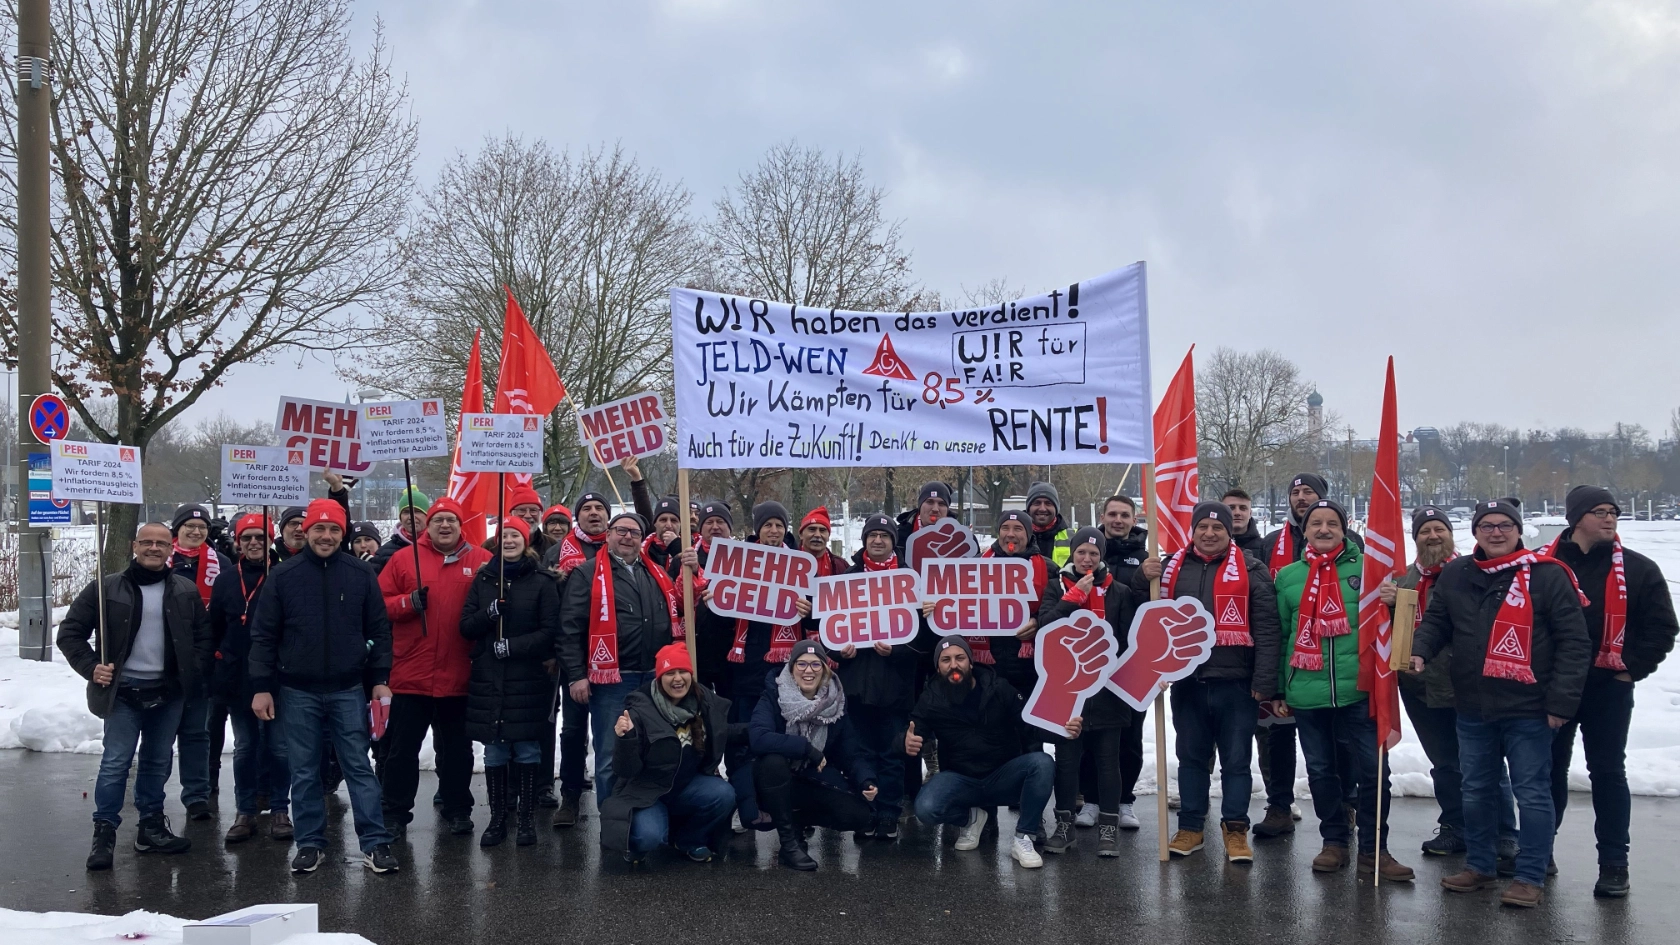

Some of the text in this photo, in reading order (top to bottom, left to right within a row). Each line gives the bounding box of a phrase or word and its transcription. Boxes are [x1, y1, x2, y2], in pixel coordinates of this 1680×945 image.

[695, 283, 1080, 335] W!R haben das verdient!
[696, 338, 848, 386] JELD-WEN
[957, 328, 1079, 364] W!R für
[963, 361, 1025, 384] FA!R
[370, 406, 392, 416] PERI
[707, 380, 759, 417] Wir
[876, 379, 918, 413] für
[922, 371, 966, 410] 8,5
[973, 388, 996, 405] %
[281, 402, 360, 439] MEH
[473, 418, 494, 426] PERI
[581, 395, 663, 440] MEHR
[688, 431, 723, 459] Auch
[728, 430, 755, 458] für
[759, 428, 784, 457] die
[923, 440, 940, 450] an
[944, 441, 987, 453] unsere
[987, 396, 1110, 455] RENTE!
[64, 445, 88, 454] PERI
[233, 449, 256, 458] PERI
[593, 424, 664, 464] GELD
[710, 544, 812, 589] MEHR
[926, 564, 1030, 595] MEHR
[713, 579, 800, 620] GELD
[818, 574, 918, 612] MEHR
[825, 608, 913, 644] GELD
[933, 598, 1024, 630] GELD
